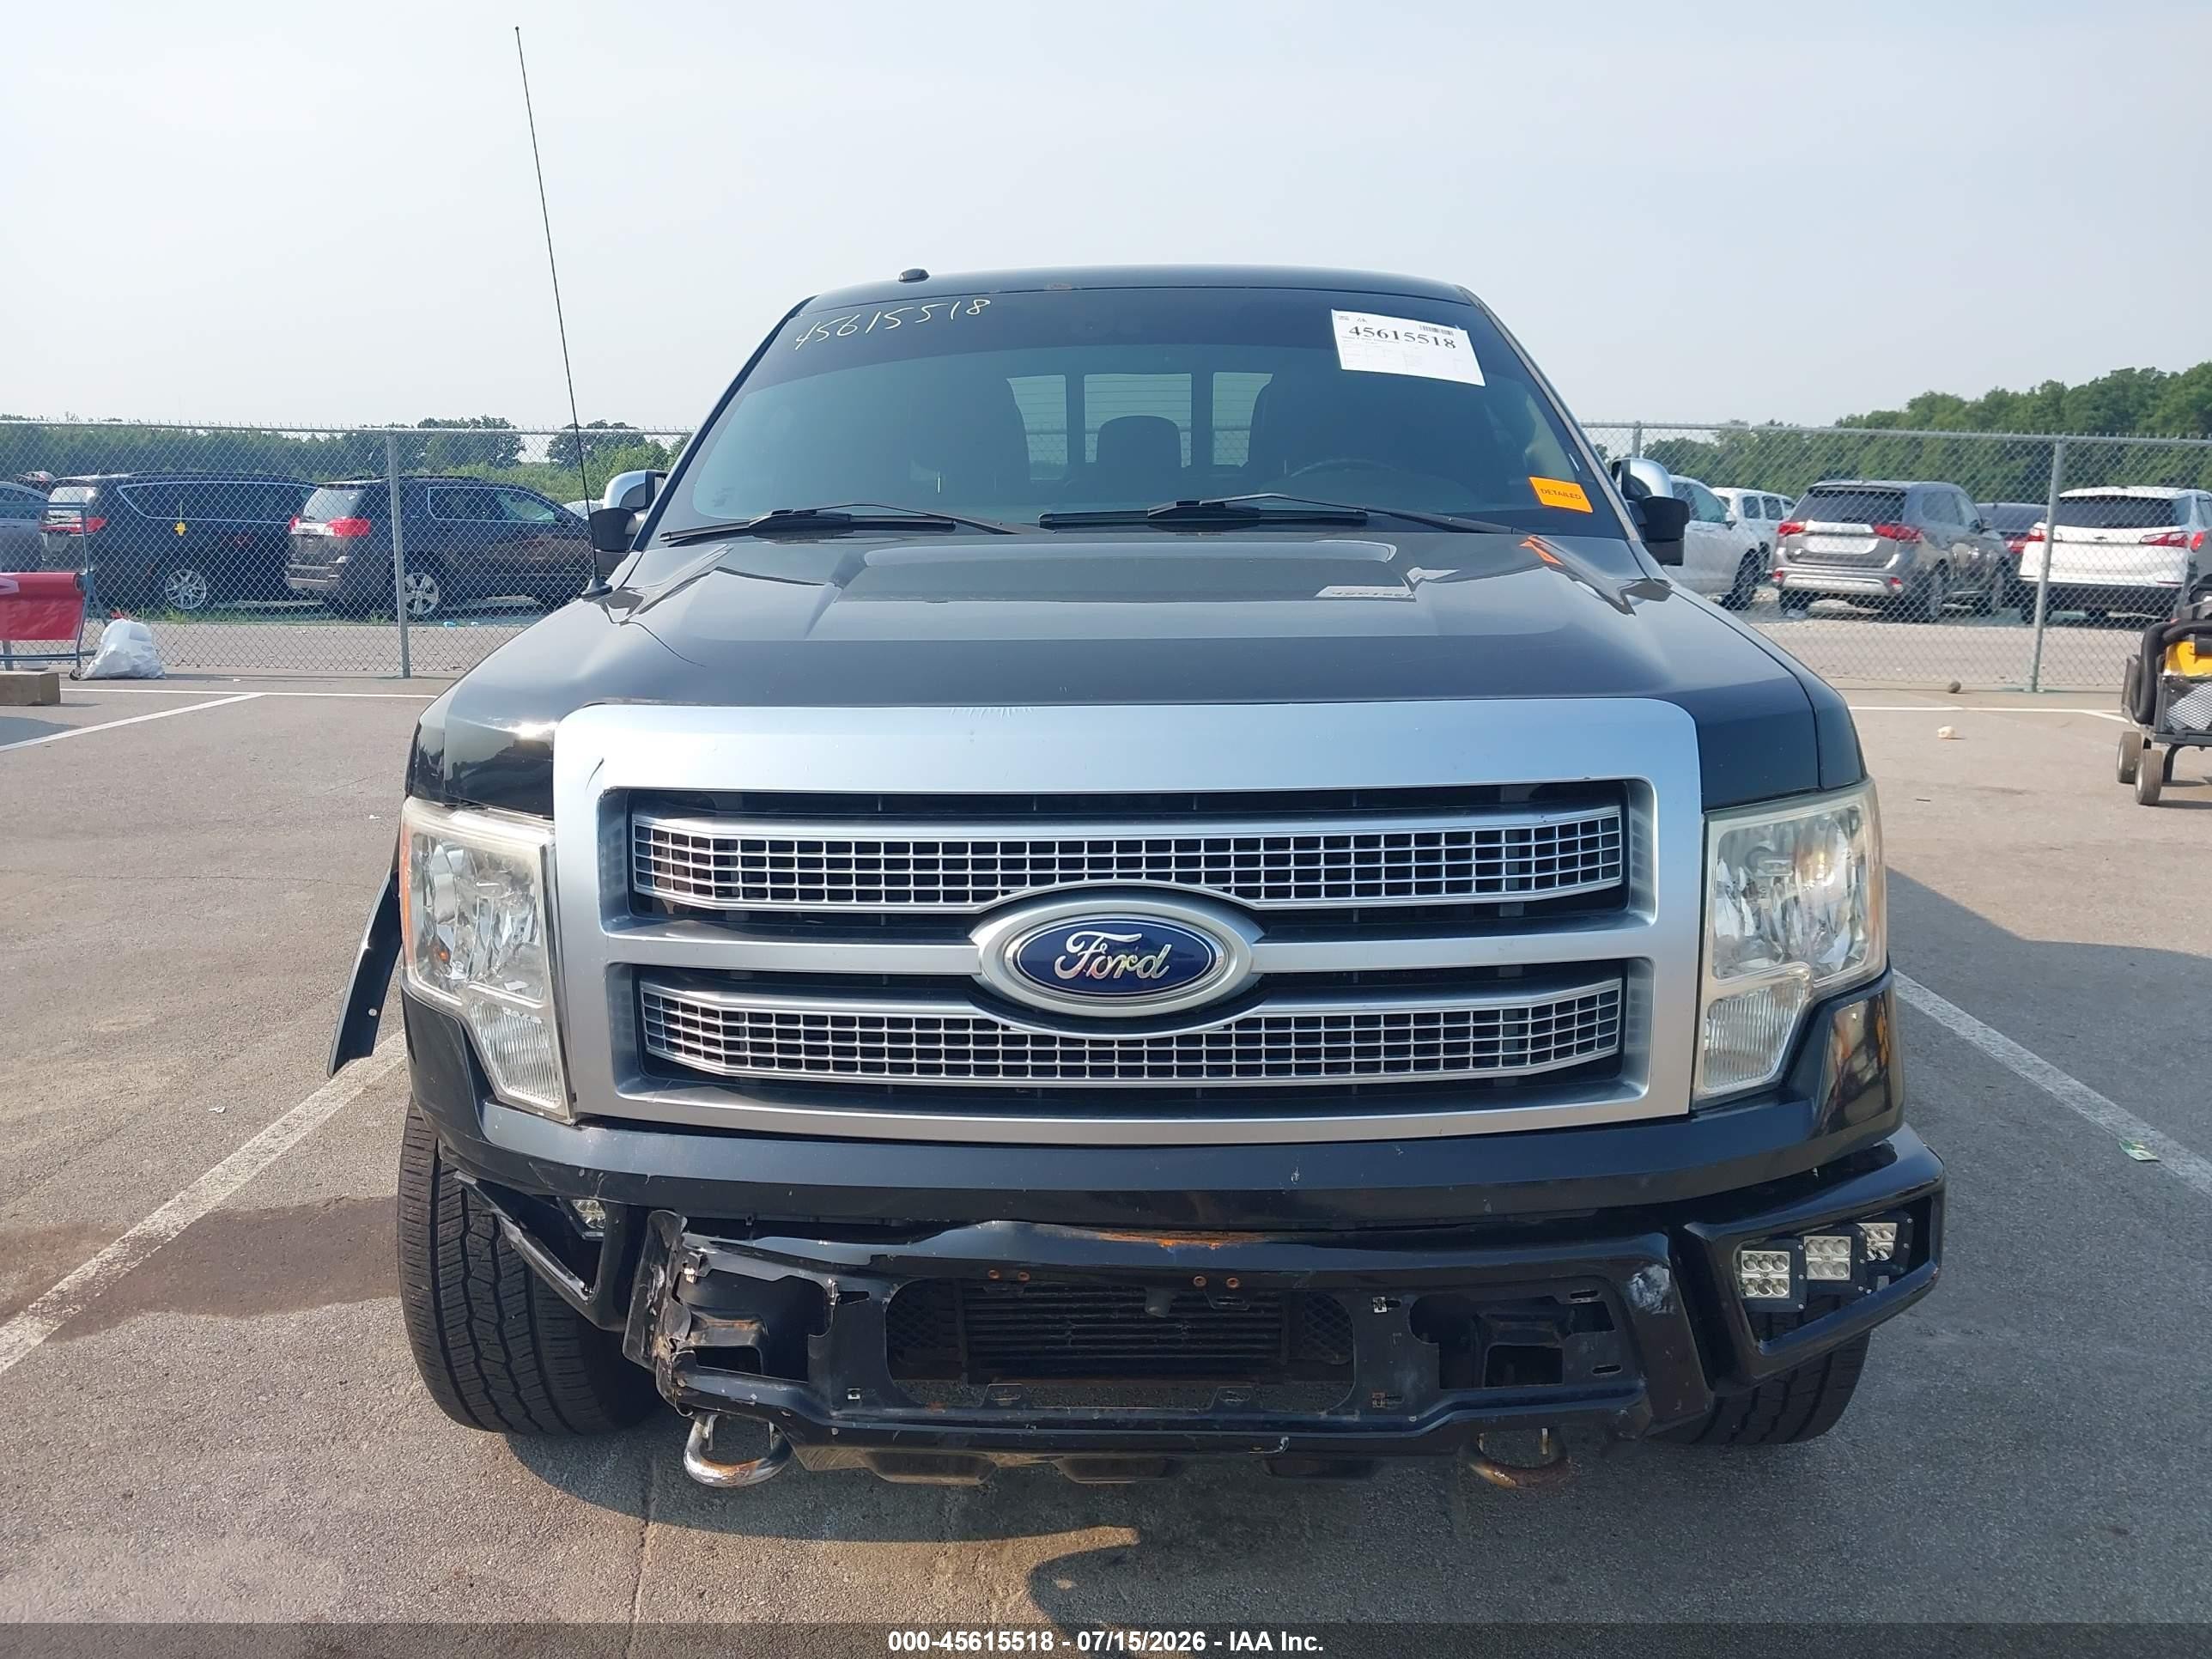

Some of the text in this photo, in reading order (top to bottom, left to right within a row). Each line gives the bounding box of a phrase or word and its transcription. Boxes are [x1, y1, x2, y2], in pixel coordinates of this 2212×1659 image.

[794, 299, 991, 351] 45615518
[1348, 325, 1457, 350] 45615518
[1540, 488, 1582, 500] DETAILED
[1054, 930, 1173, 979] Ford
